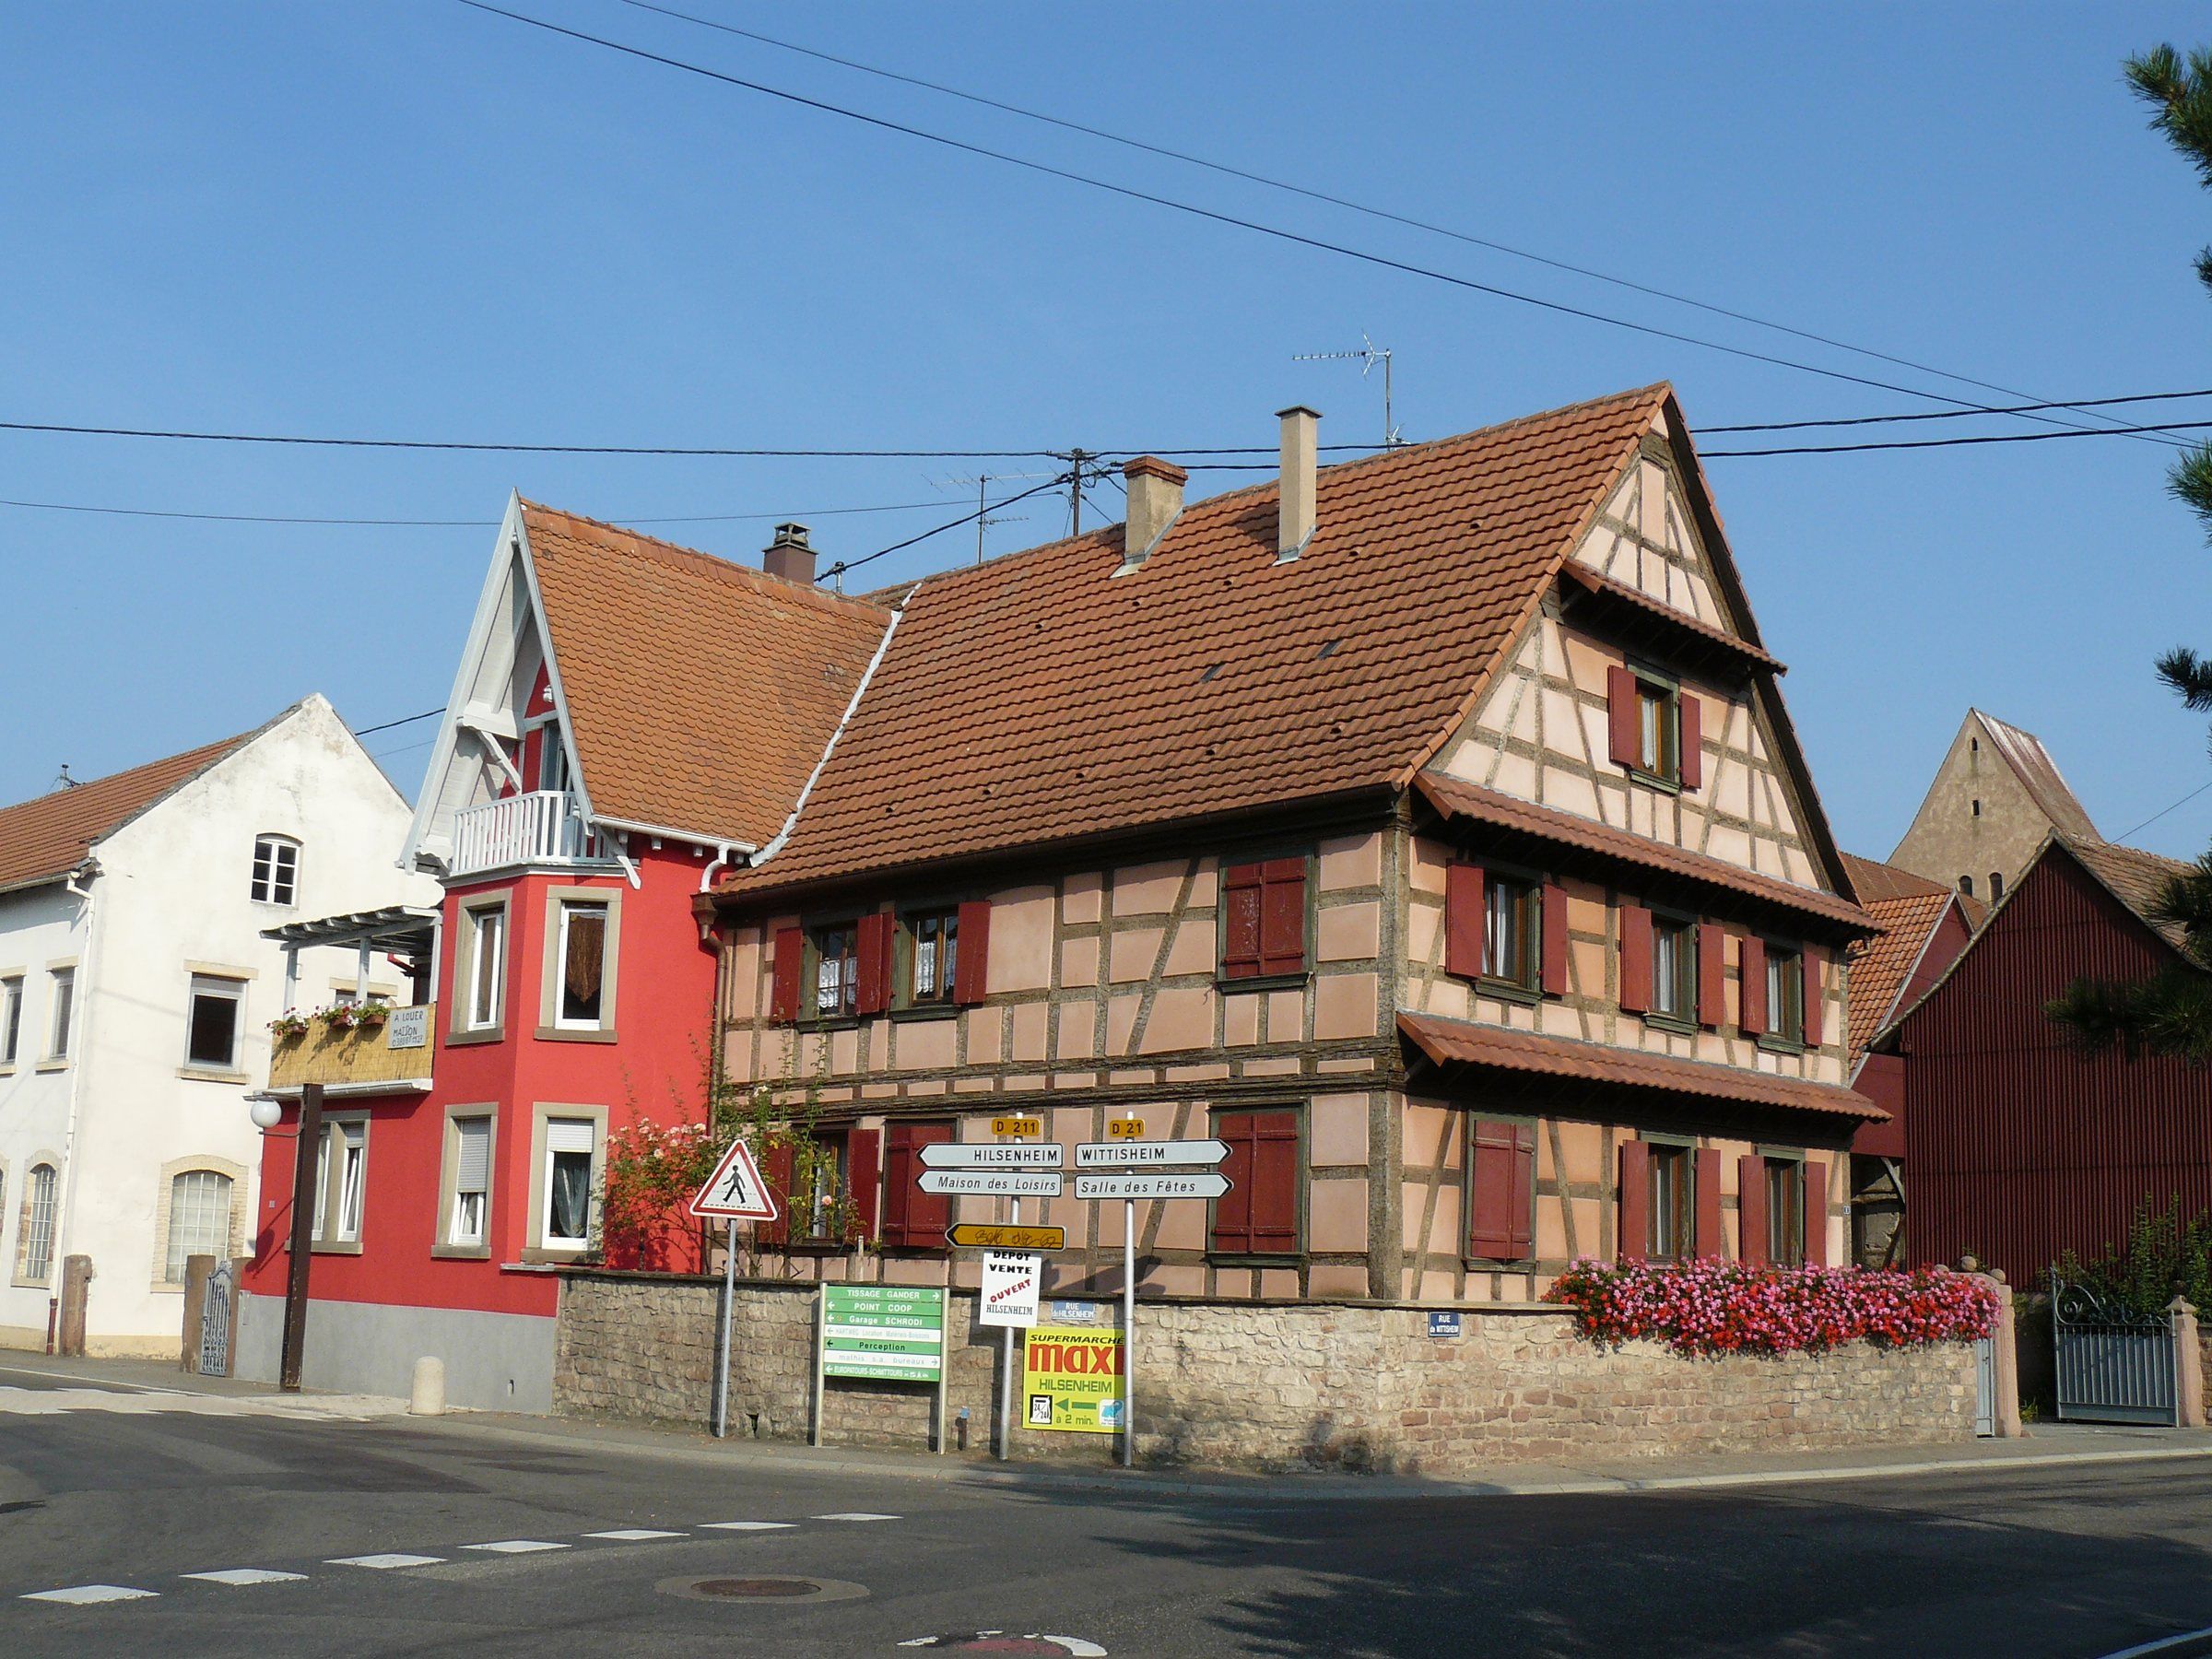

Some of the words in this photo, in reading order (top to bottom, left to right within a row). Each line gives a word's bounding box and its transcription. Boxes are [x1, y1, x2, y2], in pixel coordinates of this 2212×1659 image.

[402, 1010, 424, 1022] LOUER
[393, 1025, 418, 1037] MAISON
[996, 1121, 1005, 1132] D
[1013, 1121, 1036, 1133] 211
[1112, 1123, 1120, 1135] D
[1126, 1123, 1142, 1134] 21
[973, 1149, 1058, 1161] HILSENHEIM
[1081, 1147, 1166, 1160] WITTISHEIM
[937, 1176, 981, 1189] Maison
[987, 1178, 1008, 1190] des
[1015, 1178, 1056, 1191] Loisirs
[1080, 1181, 1117, 1193] Salle
[1124, 1181, 1148, 1193] des
[1156, 1180, 1195, 1192] Fêtes
[993, 1250, 1031, 1261] DEPOT
[988, 1264, 1033, 1275] VENTE
[846, 1289, 881, 1299] TISSAGE
[886, 1290, 920, 1300] GANDER
[990, 1278, 1031, 1303] OUVERT
[853, 1302, 881, 1312] POINT
[887, 1303, 912, 1312] COOP
[985, 1303, 1033, 1316] HILSENHEIM
[1065, 1301, 1080, 1311] RUE
[1059, 1310, 1095, 1318] HILSENHEIM
[1438, 1314, 1452, 1324] RUE
[849, 1315, 878, 1324] Garage
[885, 1317, 923, 1326] SCHRODI
[1030, 1334, 1125, 1345] SUPERMARCHÉ
[859, 1341, 906, 1351] Perception
[839, 1354, 865, 1362] mathis
[892, 1357, 924, 1365] bureaux
[1039, 1378, 1112, 1394] HILSENHEIM
[1055, 1414, 1062, 1424] à
[1065, 1414, 1073, 1424] 2
[1075, 1415, 1094, 1425] min.
